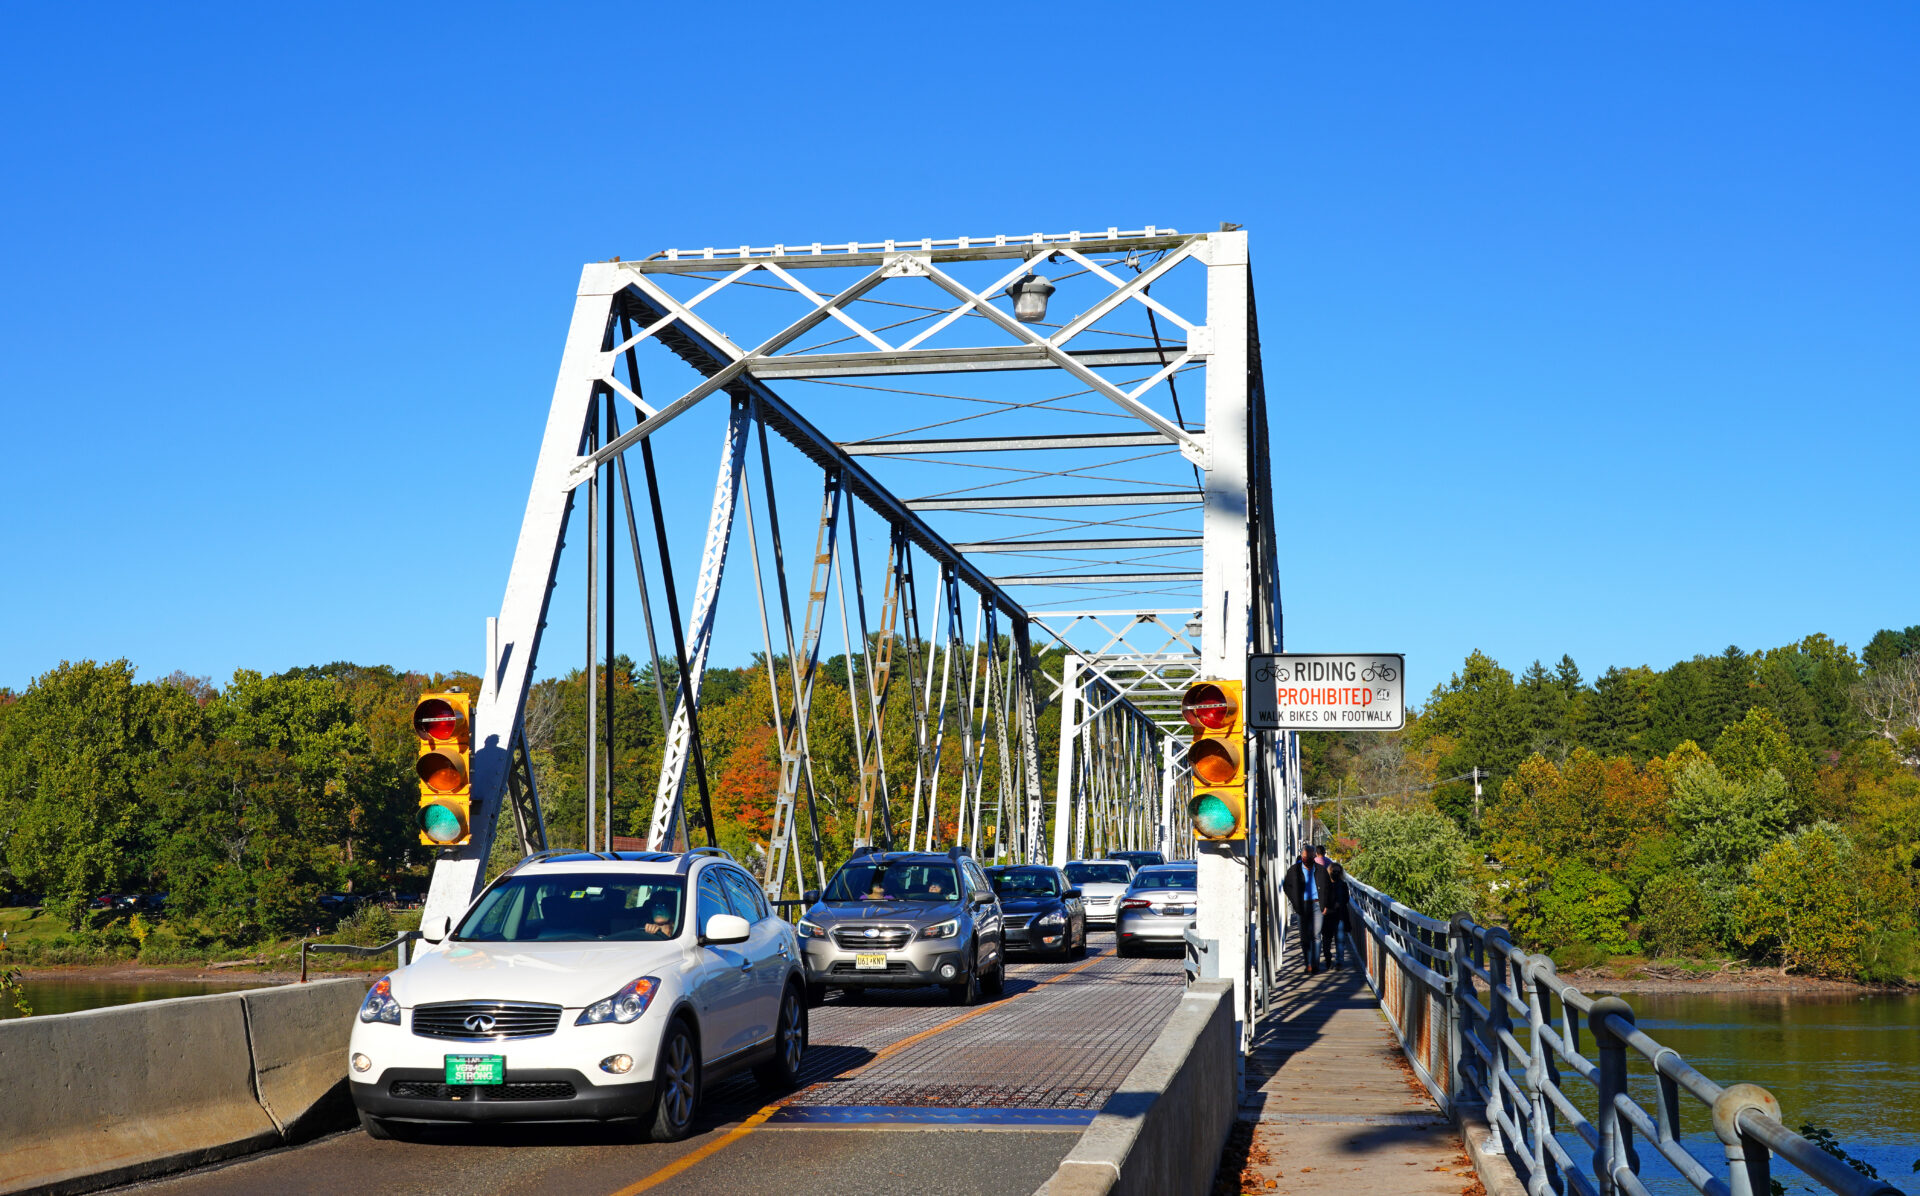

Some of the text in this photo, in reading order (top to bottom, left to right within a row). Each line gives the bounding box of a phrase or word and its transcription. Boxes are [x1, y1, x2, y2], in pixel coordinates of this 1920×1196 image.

[1294, 661, 1356, 682] RIDING
[1277, 687, 1373, 705] PROHIBITED
[1259, 710, 1392, 722] WALK BIKES ON FOOTWALK
[455, 1064, 494, 1072] VERMONT
[455, 1071, 494, 1081] STRONG
